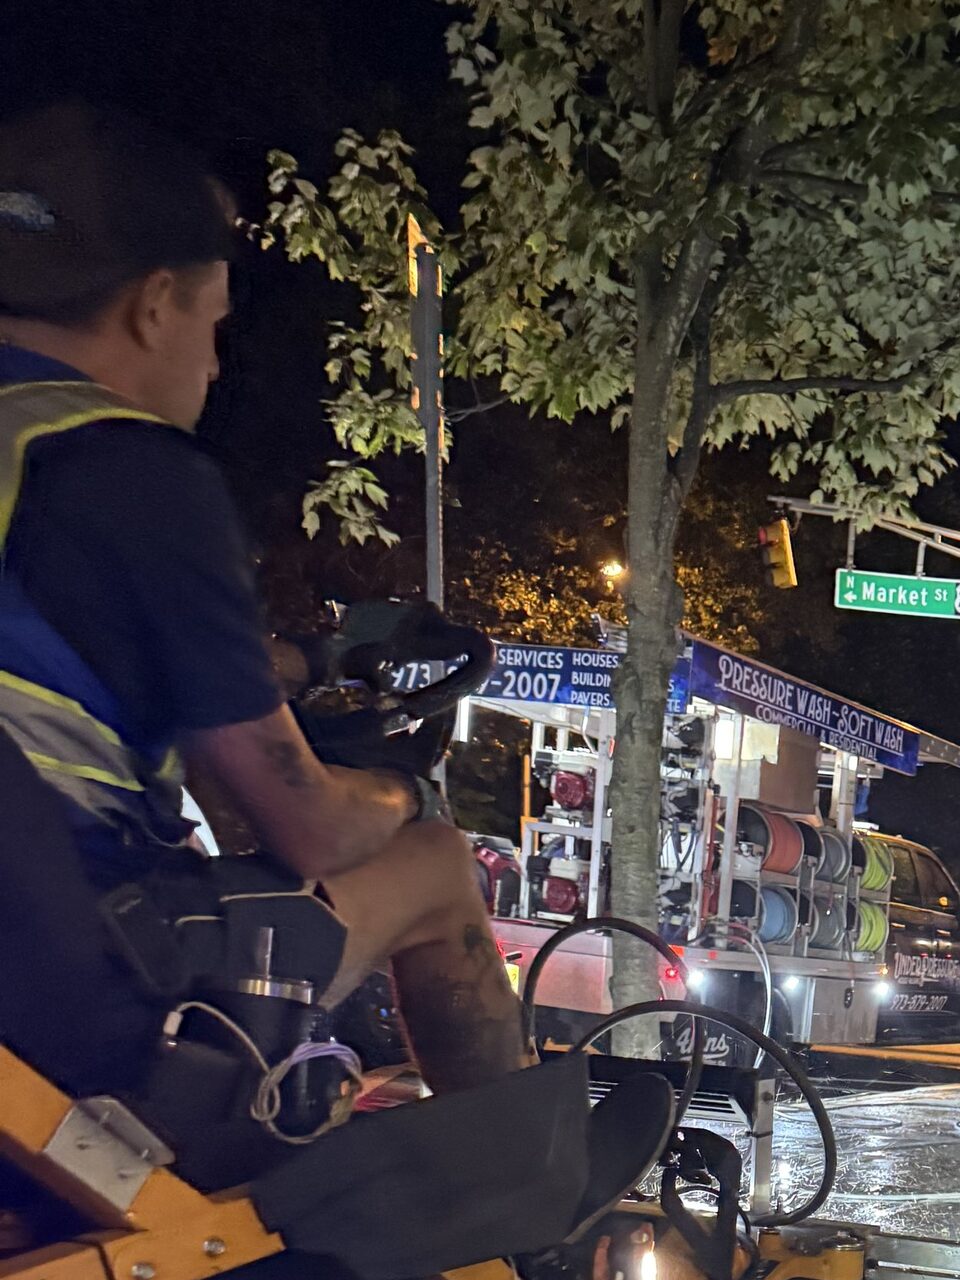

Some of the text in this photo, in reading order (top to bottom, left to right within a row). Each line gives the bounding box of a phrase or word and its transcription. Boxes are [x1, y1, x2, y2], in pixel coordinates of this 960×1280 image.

[846, 575, 948, 607] N Market St
[498, 648, 564, 669] SERVICES
[572, 652, 619, 669] HOUSES
[570, 690, 610, 707] PAVERS
[714, 654, 795, 711] PRESSURE
[874, 719, 904, 752] WASH
[828, 731, 878, 761] RESIDENTIAL
